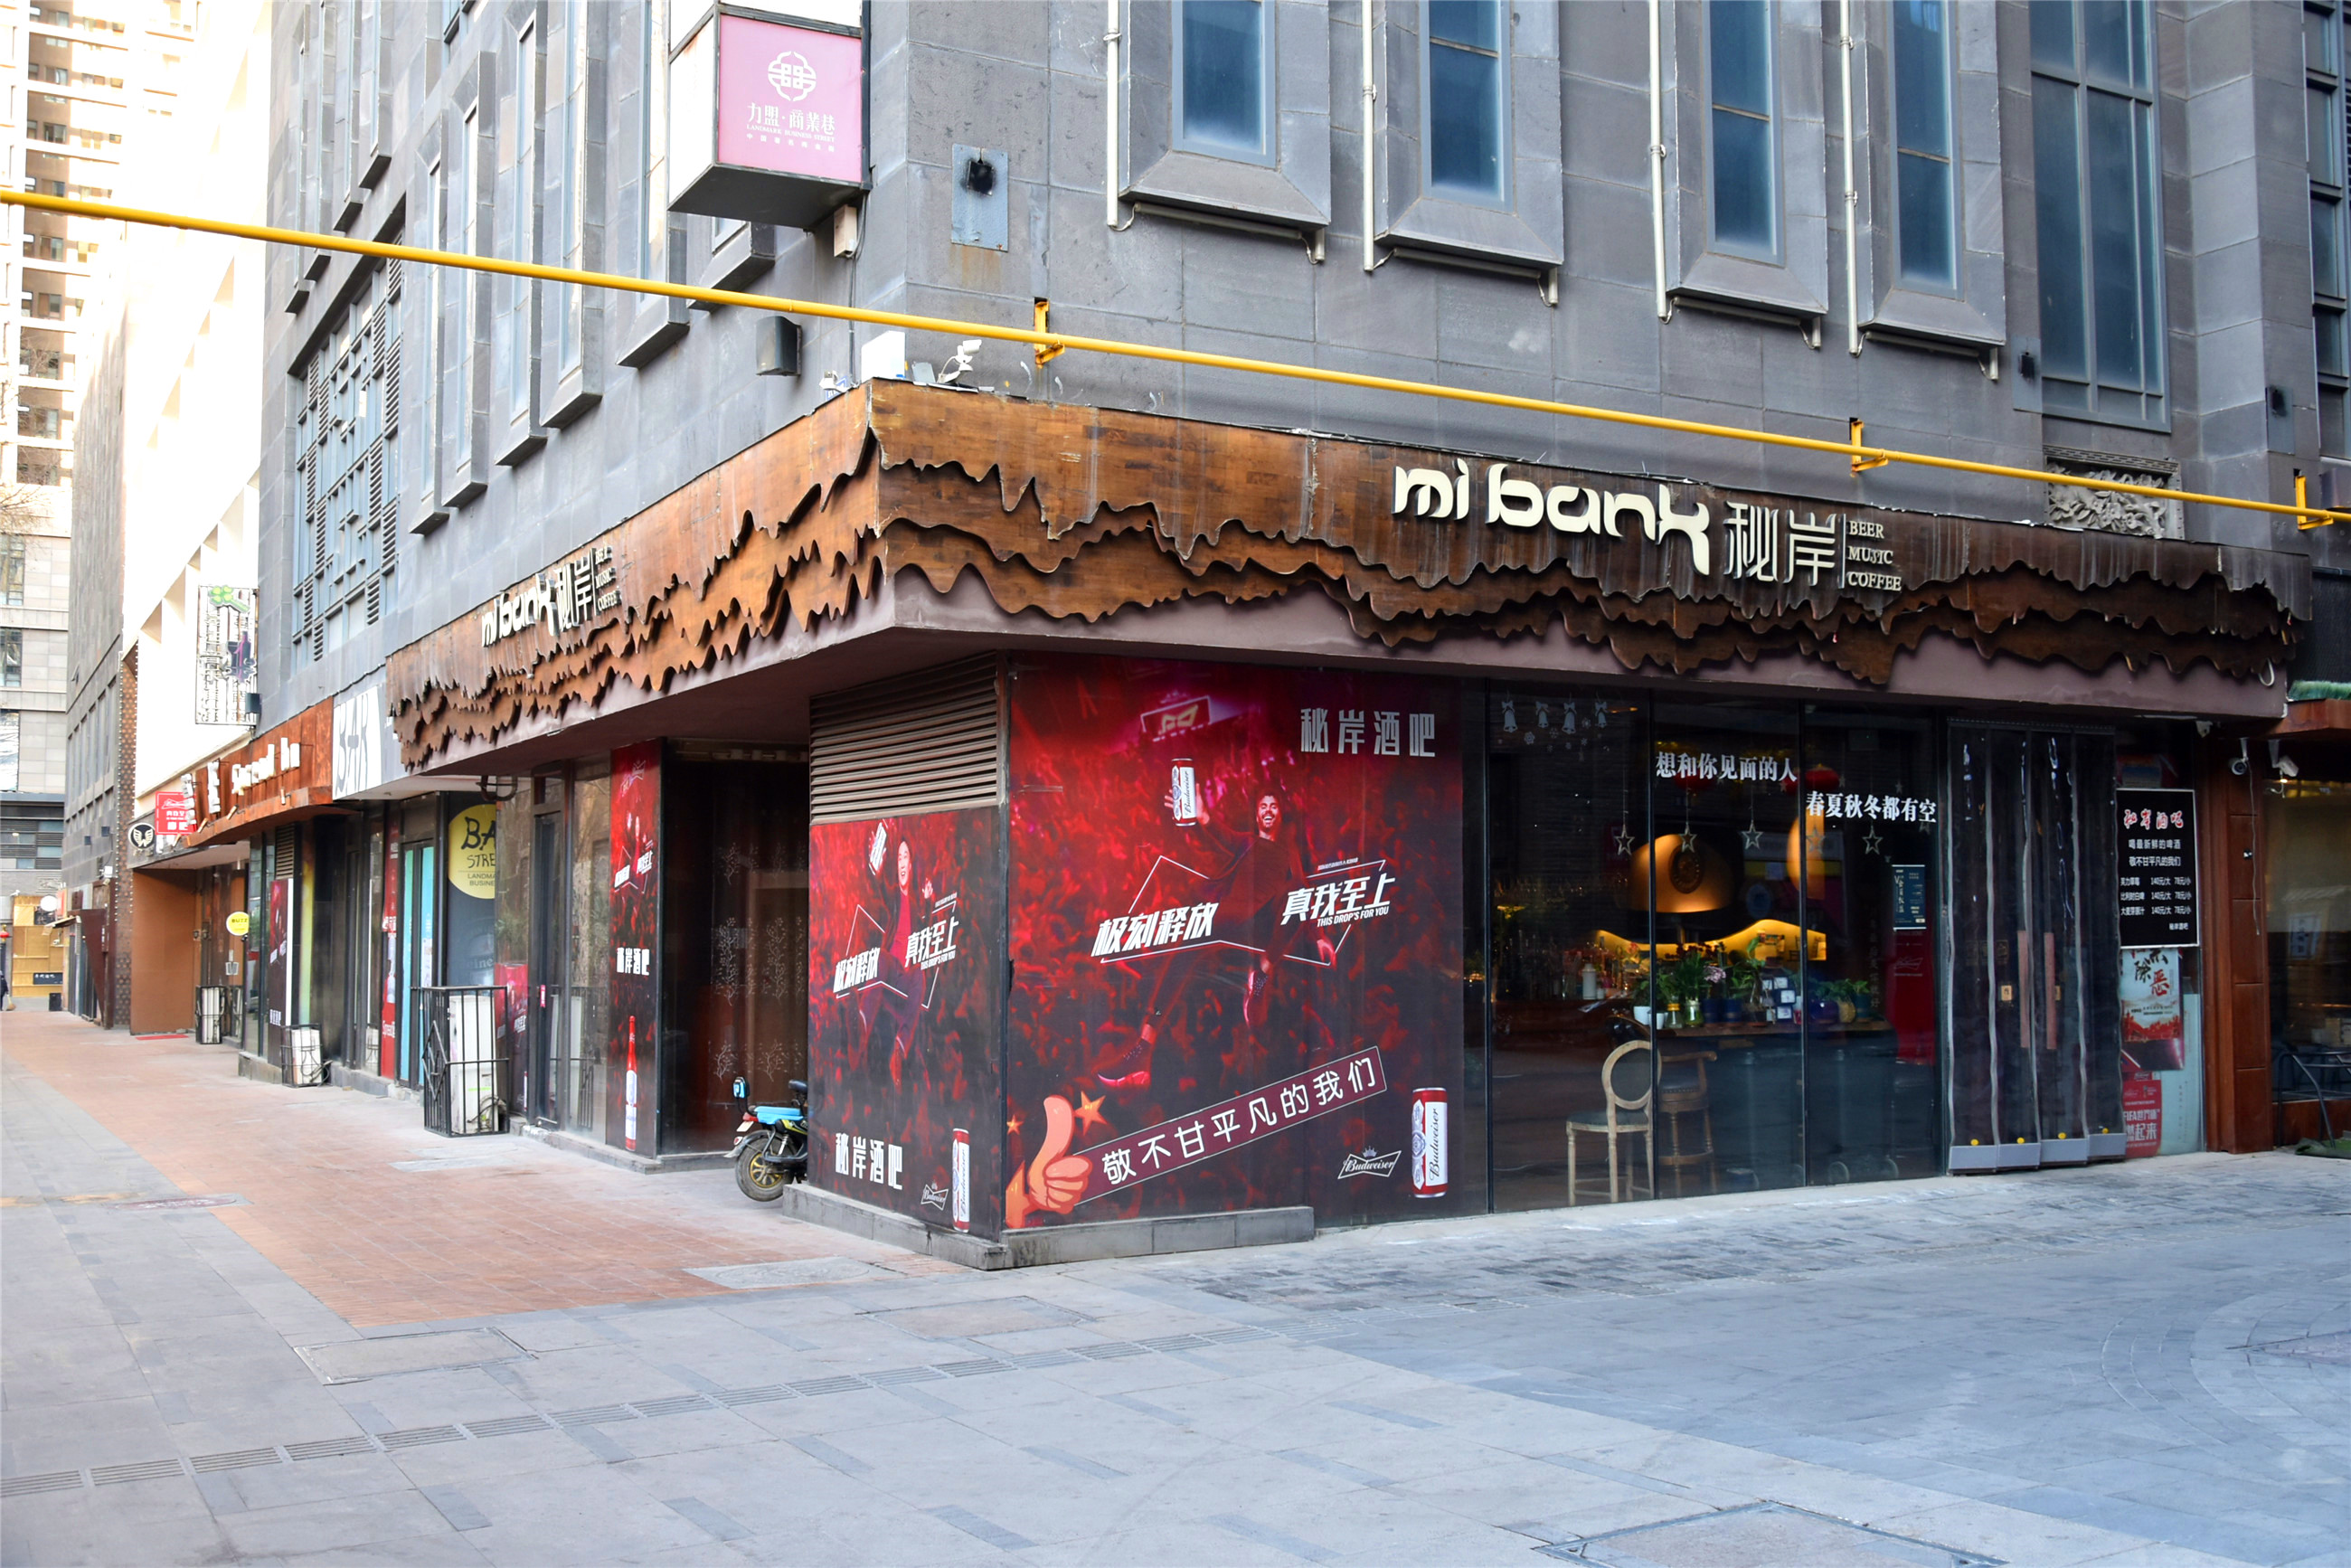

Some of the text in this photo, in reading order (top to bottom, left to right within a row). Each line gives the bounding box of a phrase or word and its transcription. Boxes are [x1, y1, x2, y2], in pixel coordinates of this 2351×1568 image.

[1393, 458, 1710, 576] mi bank
[1848, 520, 1884, 539] BEER
[1723, 501, 1836, 587] 秘岸
[1847, 545, 1894, 565] MUSIC
[1847, 571, 1903, 591] COFFEE
[1300, 707, 1436, 758] 秘岸酒吧
[1656, 751, 1798, 782] 想和你见面的人
[1806, 790, 1937, 823] 春夏秋冬都有空
[1280, 873, 1396, 926] 真我至上
[1317, 905, 1390, 928] THIS DROP'S FOR YOU
[904, 916, 959, 968] 真我至上
[1091, 902, 1219, 958] 极刻释放
[1101, 1057, 1377, 1185] 敬不甘平凡的我们
[1429, 1108, 1440, 1181] Budweiser
[835, 1132, 903, 1191] 秘岸酒吧
[1343, 1158, 1394, 1173] Budweiser
